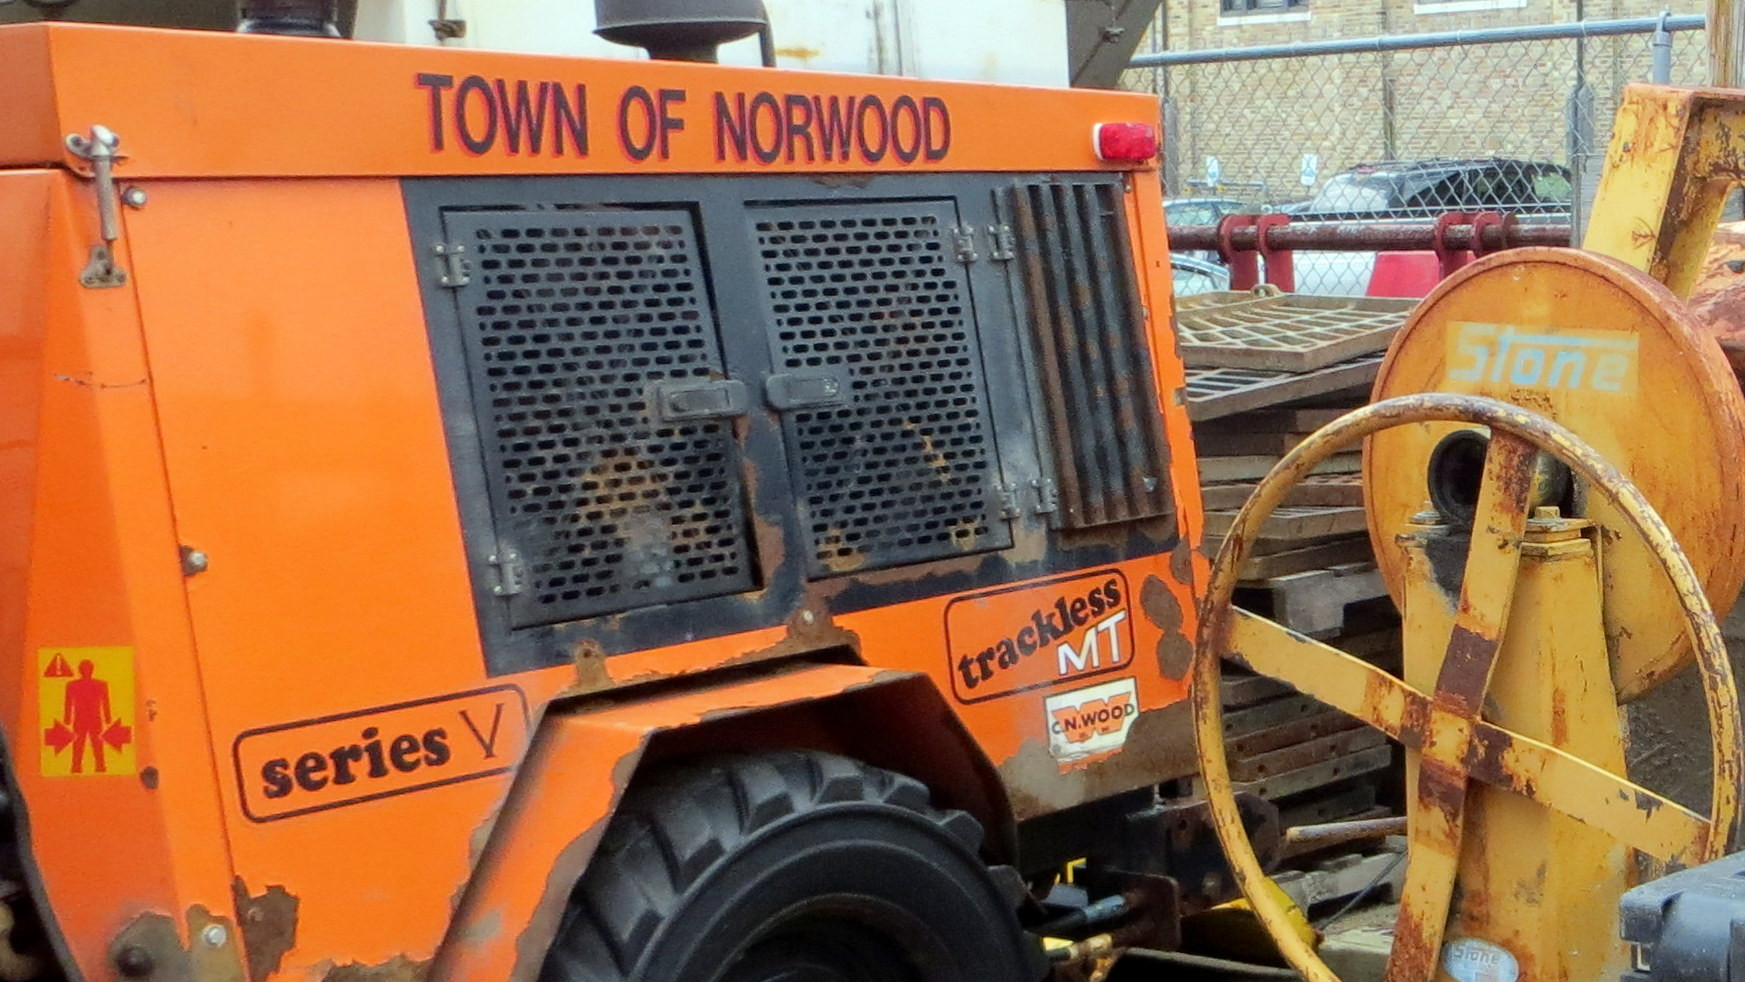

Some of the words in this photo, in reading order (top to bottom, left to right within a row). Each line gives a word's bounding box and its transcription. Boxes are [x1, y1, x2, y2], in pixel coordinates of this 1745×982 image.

[414, 73, 589, 157] TOWN
[617, 85, 687, 163] OF
[713, 91, 951, 166] NORWOOD
[1447, 322, 1640, 392] Stone
[957, 578, 1121, 689] trackless
[1057, 609, 1126, 675] MT
[261, 727, 451, 799] series
[459, 703, 504, 759] V
